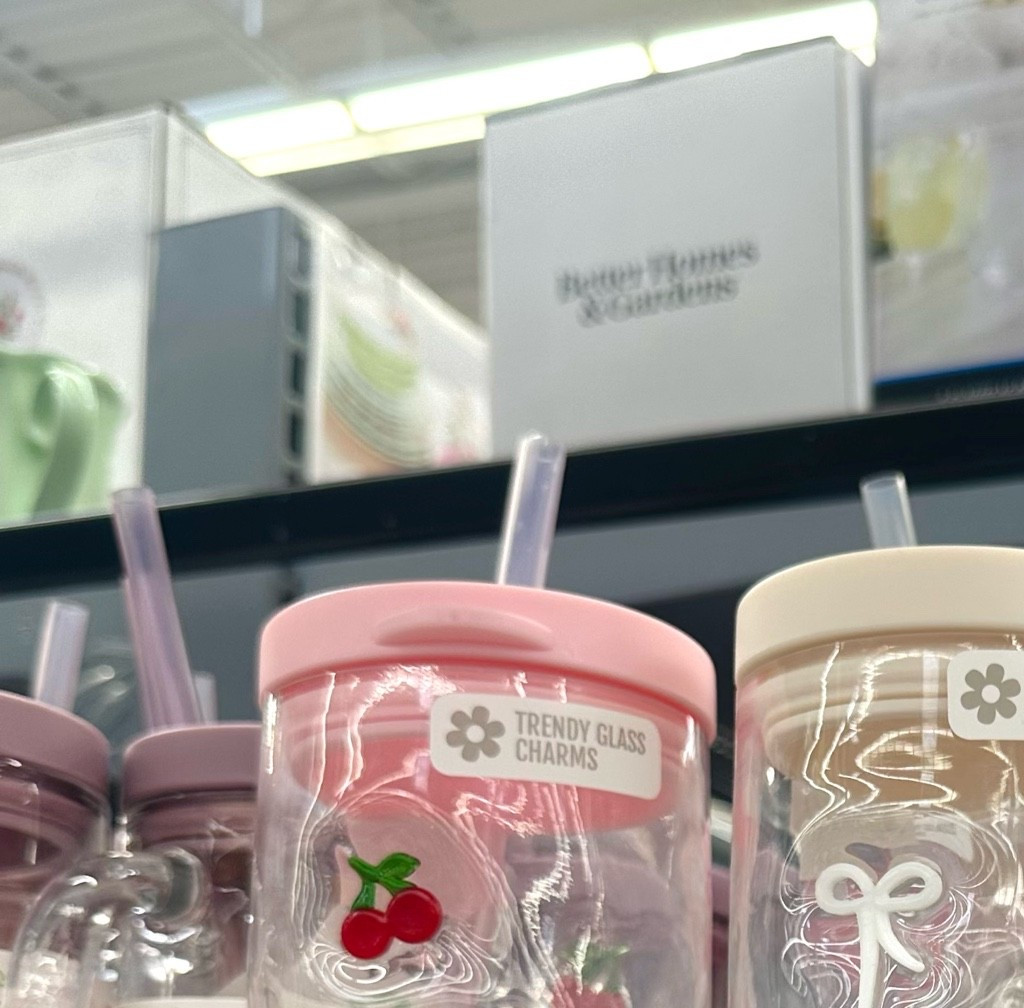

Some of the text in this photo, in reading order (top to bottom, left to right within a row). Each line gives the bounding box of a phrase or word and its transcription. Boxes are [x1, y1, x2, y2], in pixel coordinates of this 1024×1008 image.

[515, 711, 646, 755] TRENDY GLASS
[515, 739, 598, 771] CHARMS
